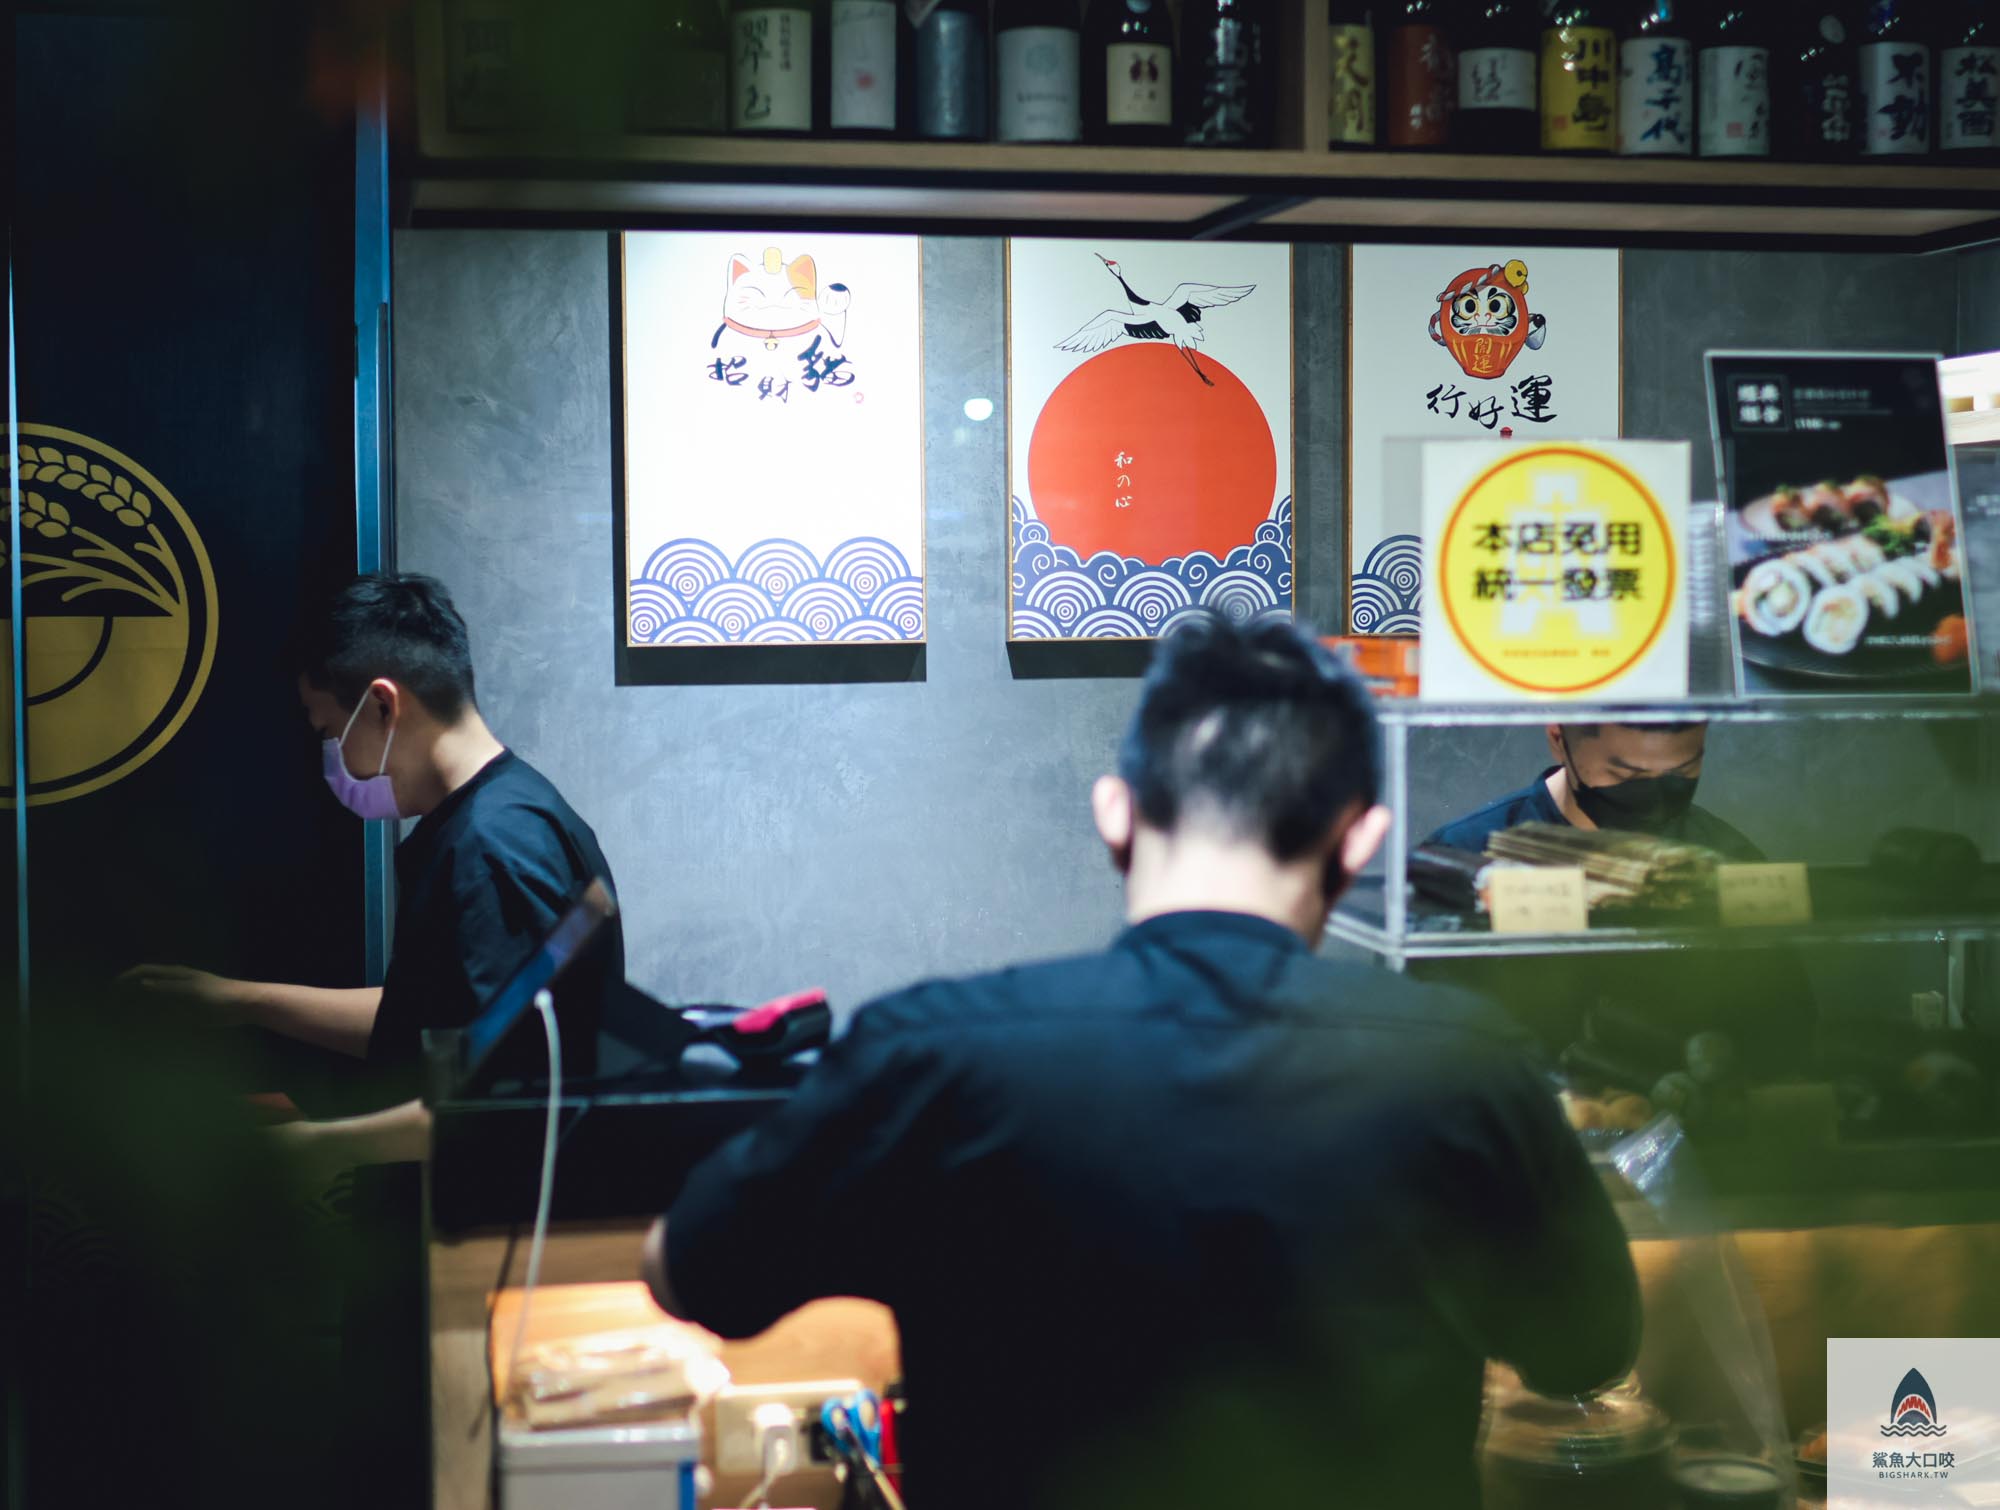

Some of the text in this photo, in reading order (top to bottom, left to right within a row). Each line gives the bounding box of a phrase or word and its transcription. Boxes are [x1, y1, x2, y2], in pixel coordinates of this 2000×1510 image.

[1640, 44, 1685, 144] 高千代
[1426, 374, 1558, 430] 行好運
[1113, 450, 1134, 509] 和の心
[1471, 520, 1643, 556] 本店免用
[1471, 567, 1644, 602] 統一發票
